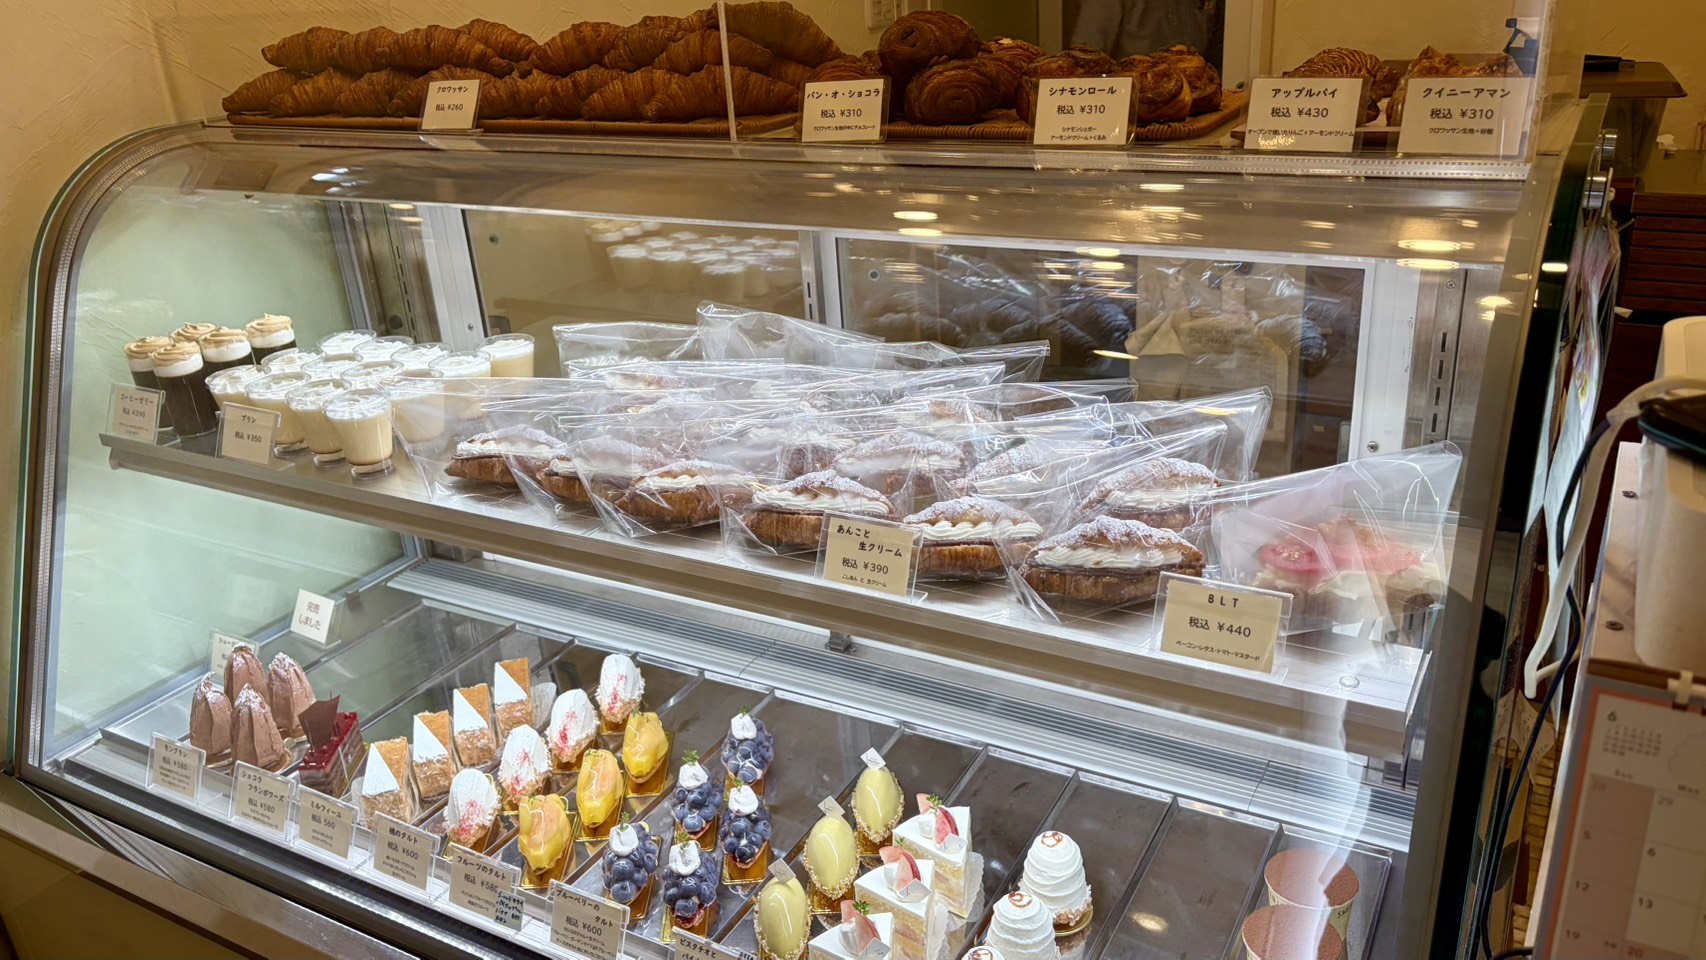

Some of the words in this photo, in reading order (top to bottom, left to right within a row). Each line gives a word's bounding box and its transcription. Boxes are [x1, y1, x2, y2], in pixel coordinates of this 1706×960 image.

[437, 86, 469, 94] クロワッサン
[807, 88, 880, 99] パン・オ・ショコラ
[1049, 86, 1117, 96] シナモンロール
[1271, 87, 1338, 98] アップルパイ
[1422, 87, 1511, 98] クイニーアマン
[821, 109, 836, 118] 税込
[840, 108, 862, 117] ¥310
[1057, 105, 1075, 115] 税込
[1080, 104, 1105, 114] ¥310
[1270, 107, 1291, 118] 税込
[1297, 107, 1329, 118] ¥430
[1430, 108, 1452, 119] 税込
[1459, 109, 1494, 119] ¥310
[120, 393, 154, 405] コーヒーゼリー
[235, 431, 244, 440] 税込
[246, 433, 262, 443] ¥350
[837, 524, 870, 539] あんこと
[858, 541, 902, 558] 生クリーム
[842, 557, 858, 570] 税込
[863, 561, 889, 575] ¥390
[842, 573, 858, 582] こしあん
[867, 579, 887, 588] 生クリーム
[306, 601, 320, 614] 完売
[299, 613, 321, 631] しました
[1188, 616, 1210, 630] 税込
[1217, 621, 1251, 638] ¥440
[1608, 709, 1617, 722] 6
[164, 744, 188, 757] モンブラン
[242, 770, 262, 783] ショコラ
[248, 784, 285, 803] フランボワーズ
[248, 797, 258, 807] 税込
[260, 802, 275, 813] ¥580
[310, 800, 342, 818] ミルフィーユ
[311, 813, 322, 824] 税込
[323, 818, 336, 829] 560
[389, 827, 418, 844] 桃のタルト
[387, 841, 398, 852] 税込
[402, 847, 419, 860] ¥600
[457, 856, 506, 881] フルーツのタルト
[464, 873, 476, 885] 税込
[1575, 880, 1590, 893] 12
[556, 889, 600, 912] ブルーベリーの
[1638, 896, 1654, 910] 13
[565, 915, 579, 928] 税込
[582, 921, 602, 936] ¥600
[595, 916, 613, 928] タルト
[1566, 929, 1581, 940] 19
[680, 938, 717, 959] ピスタチオと
[1627, 946, 1645, 959] 20
